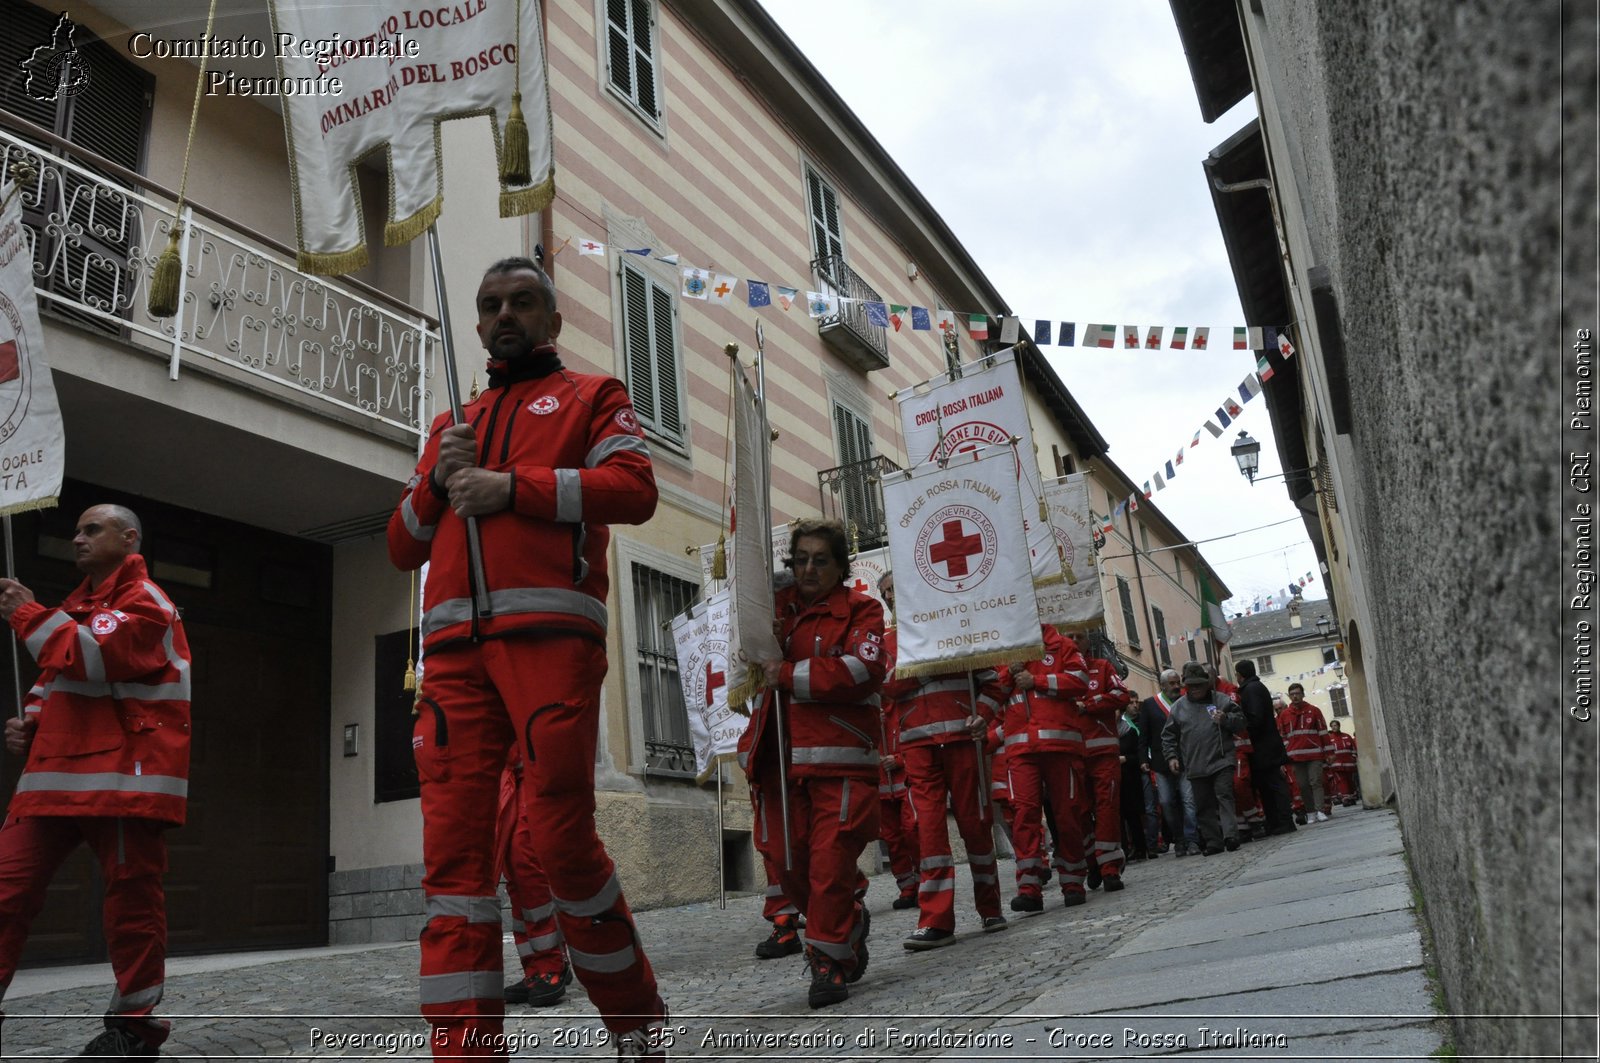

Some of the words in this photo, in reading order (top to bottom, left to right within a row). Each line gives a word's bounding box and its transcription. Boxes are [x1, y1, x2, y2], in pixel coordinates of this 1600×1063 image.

[402, 0, 487, 30] LOCALE
[402, 64, 446, 87] DEL
[450, 43, 516, 80] BOSCO
[942, 398, 968, 418] ROSSA
[968, 386, 1004, 409] ITALIANA
[974, 426, 984, 437] DI
[2, 450, 43, 472] OCALE
[900, 496, 926, 528] CROCE
[926, 480, 960, 498] ROSSA
[963, 479, 1002, 504] ITALIANA
[934, 508, 971, 522] GINEVRA
[971, 510, 982, 522] 22
[980, 519, 995, 556] AGOSTO
[916, 528, 940, 586] CONVENZIONE
[980, 557, 993, 575] 1864
[912, 604, 968, 624] COMITATO
[974, 594, 1017, 612] LOCALE
[960, 618, 970, 628] DI
[937, 630, 1000, 650] DRONERO
